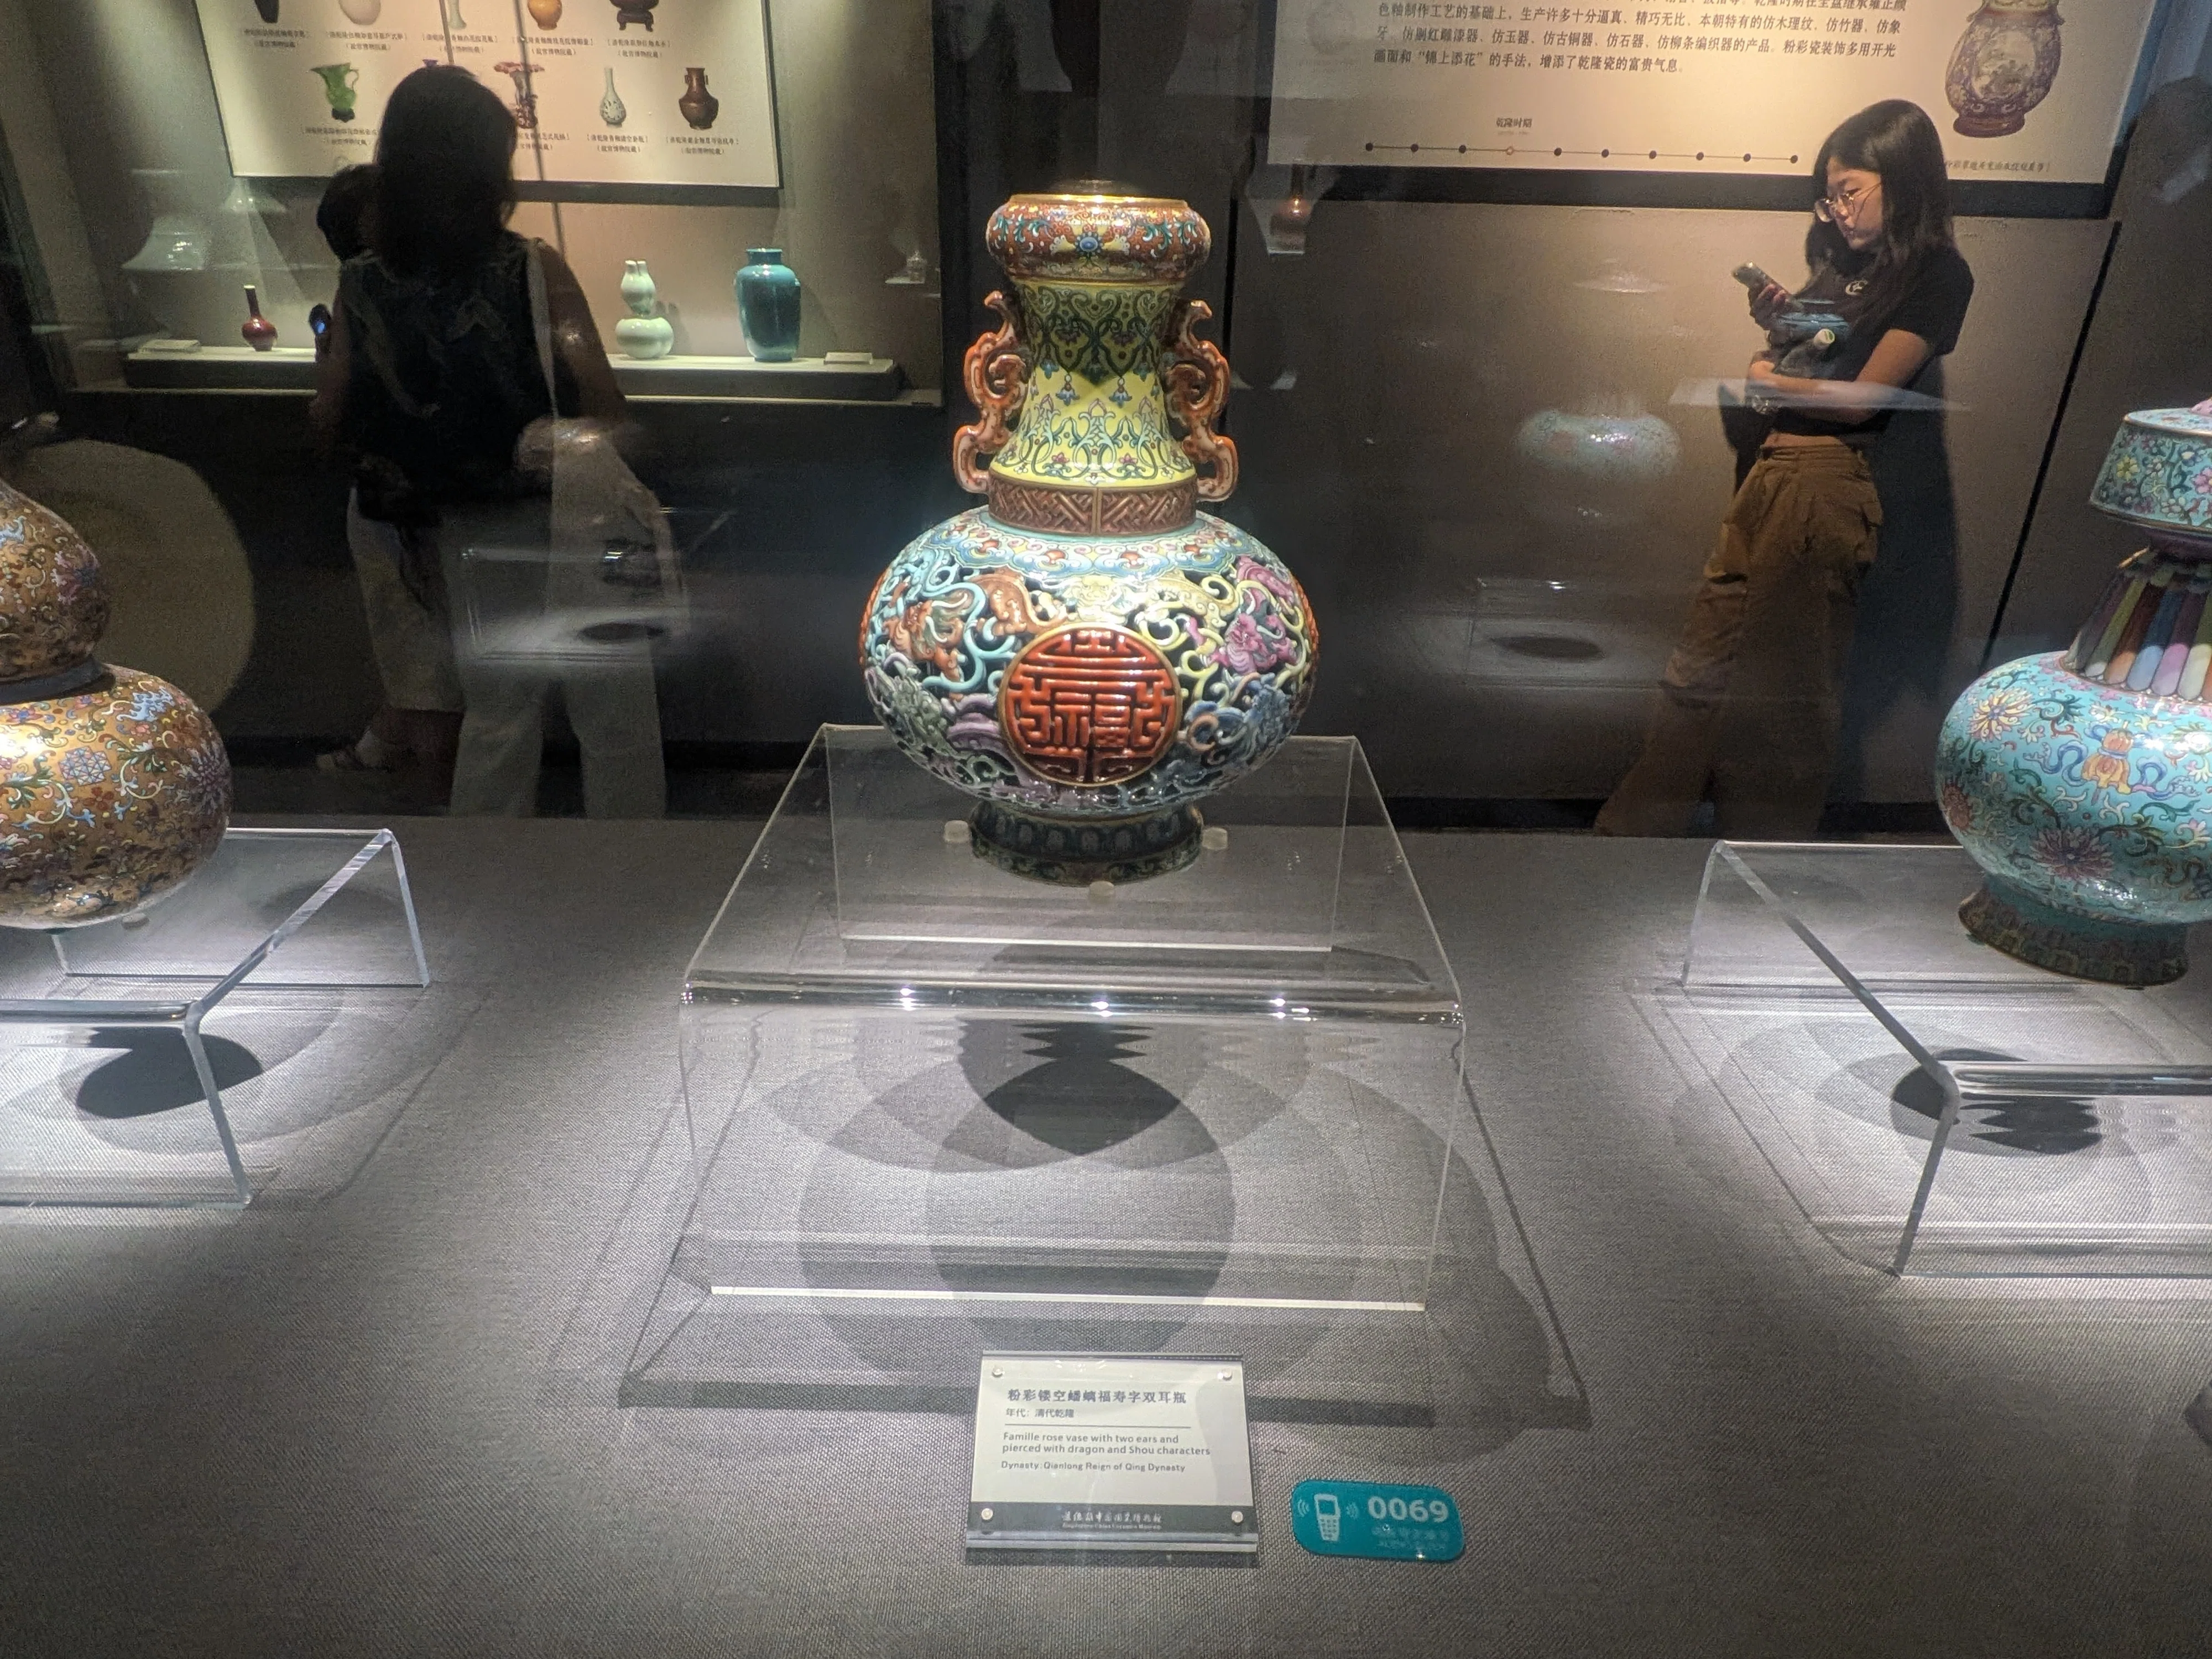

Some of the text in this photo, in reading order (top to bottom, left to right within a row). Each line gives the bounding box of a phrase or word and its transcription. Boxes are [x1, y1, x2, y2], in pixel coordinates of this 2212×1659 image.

[1008, 1389, 1186, 1404] 粉彩镂空蟠螭福寿字双耳瓶
[1004, 1432, 1040, 1441] Famille
[1091, 1434, 1113, 1442] with
[1160, 1435, 1178, 1443] and
[1003, 1443, 1041, 1453] pierced
[1044, 1444, 1065, 1453] with
[1068, 1445, 1104, 1455] dragon
[1157, 1447, 1211, 1455] characters
[1086, 1462, 1110, 1471] Reign
[1125, 1463, 1145, 1472] Qing
[1148, 1463, 1185, 1473] Dynasty
[1368, 1495, 1448, 1522] 0069
